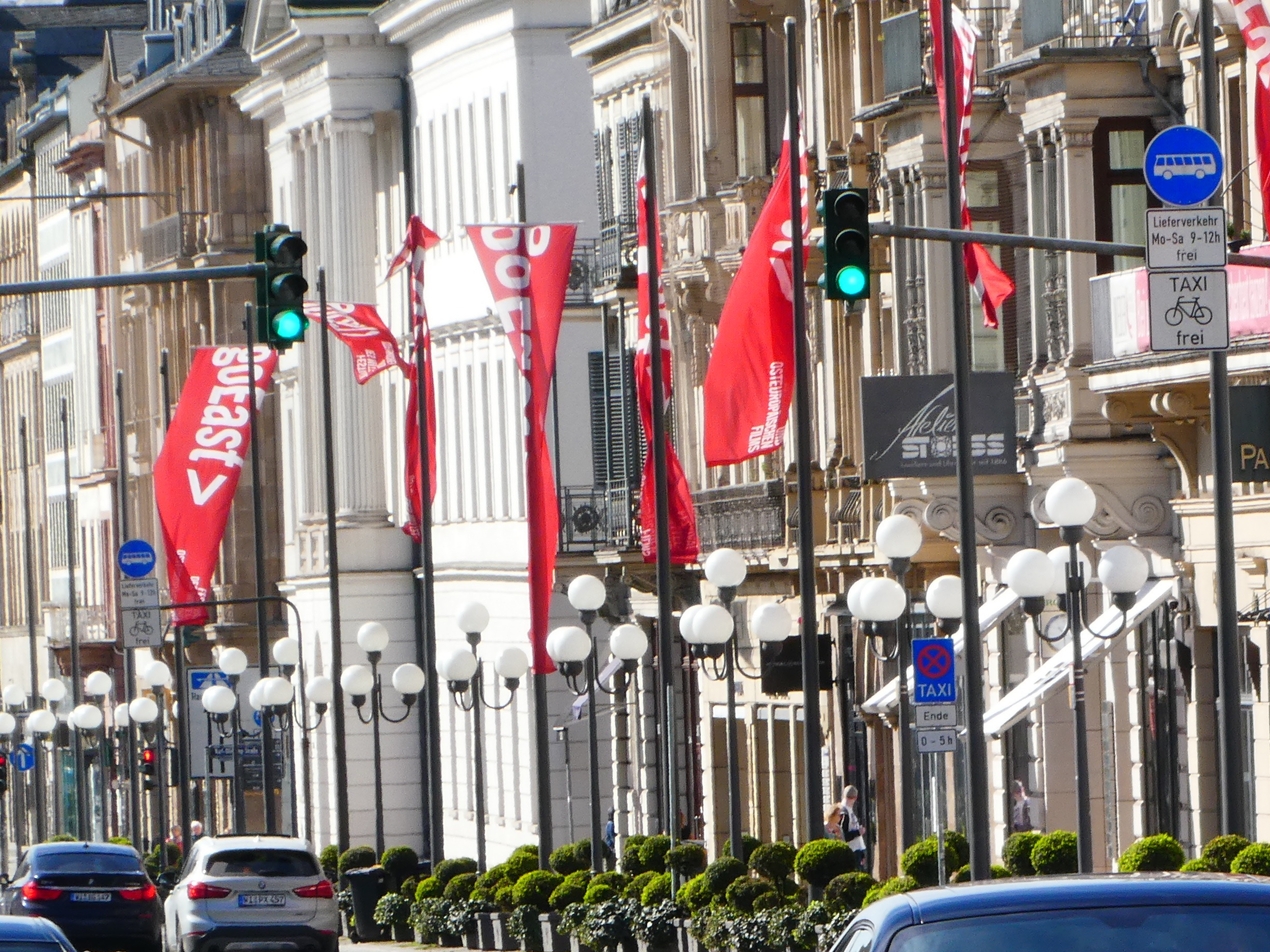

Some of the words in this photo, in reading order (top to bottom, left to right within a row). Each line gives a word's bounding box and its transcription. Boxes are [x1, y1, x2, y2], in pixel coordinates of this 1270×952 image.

[1153, 216, 1218, 228] Lieferverkehr
[1152, 232, 1184, 245] Mo-Sa
[1177, 249, 1197, 261] frei
[1169, 276, 1208, 292] TAXI
[1177, 330, 1204, 345] frei
[131, 611, 151, 619] TAXI
[917, 683, 952, 698] TAXI
[923, 711, 949, 721] Ende
